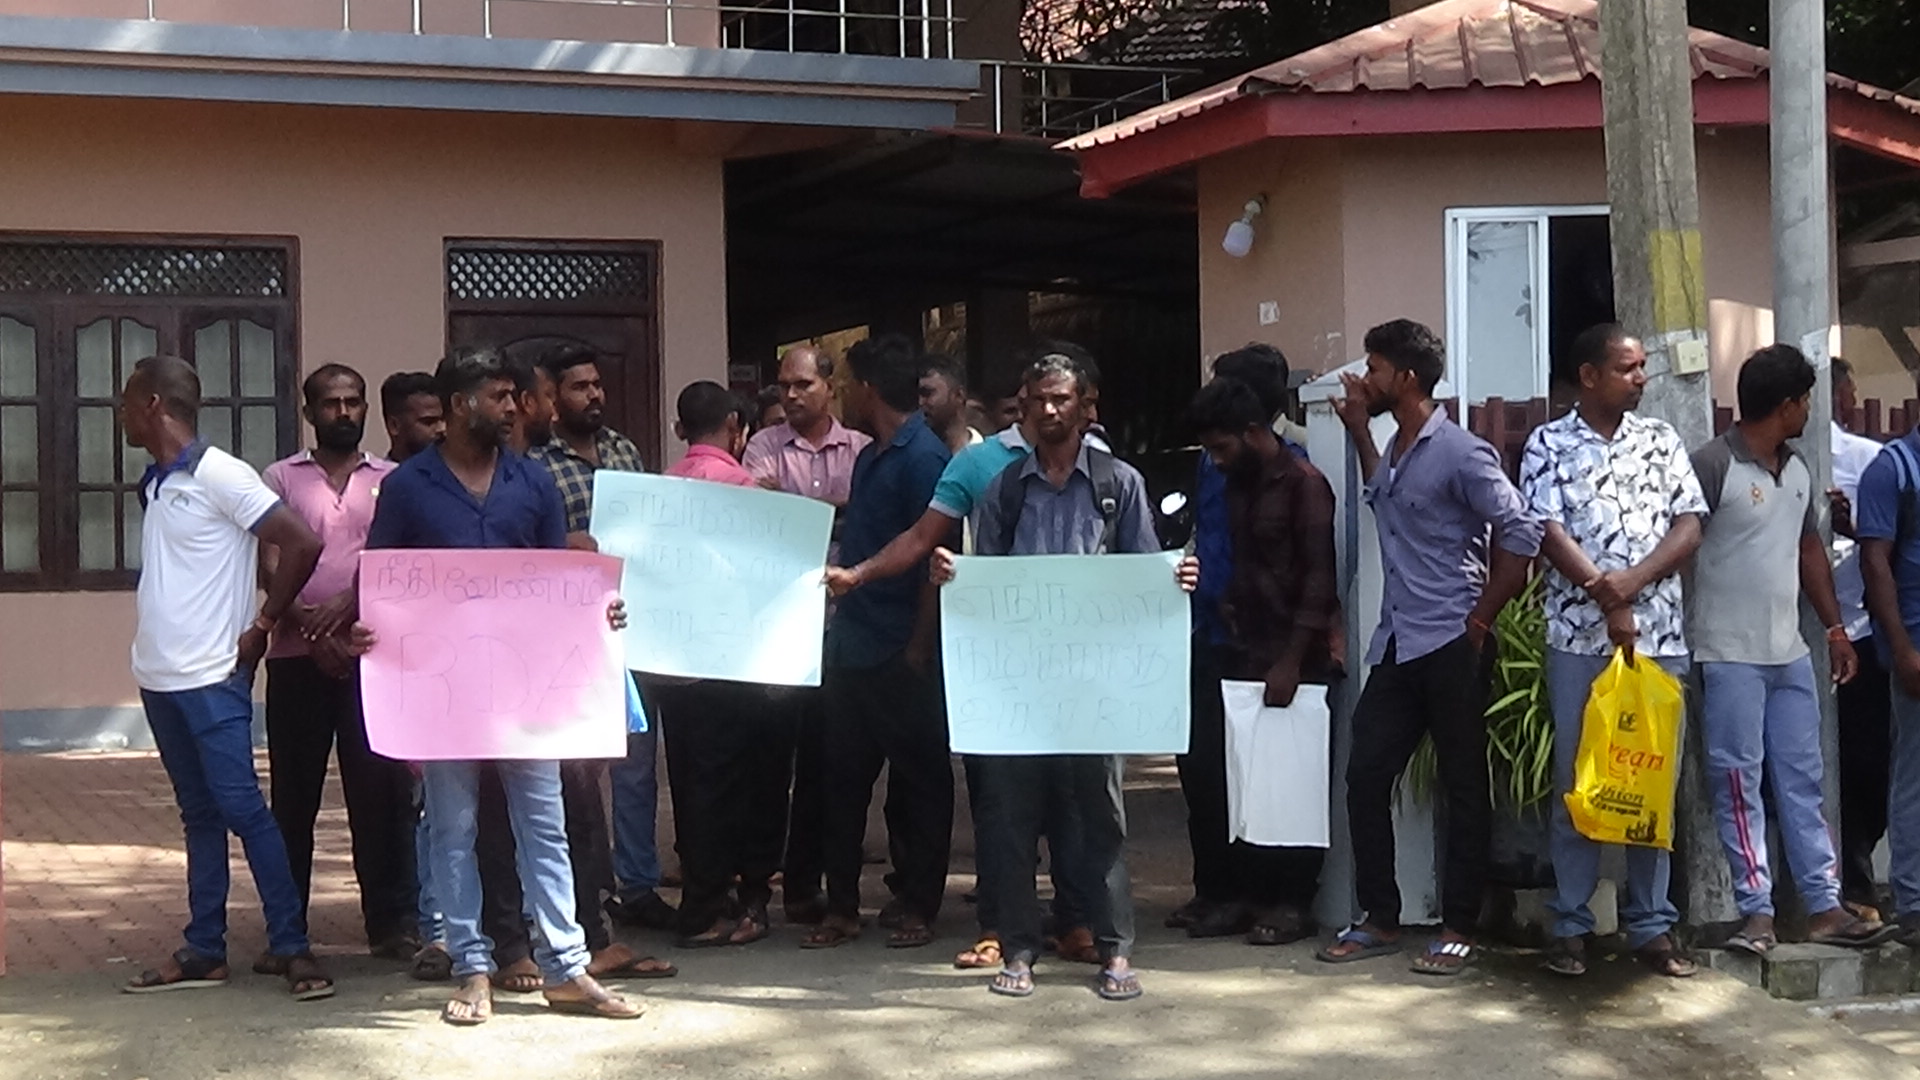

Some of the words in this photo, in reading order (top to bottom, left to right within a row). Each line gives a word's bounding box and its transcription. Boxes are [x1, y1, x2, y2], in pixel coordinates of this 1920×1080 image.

[370, 553, 437, 605] நீதி
[442, 560, 605, 608] வேண்டும்
[398, 632, 602, 718] RDA
[1091, 695, 1182, 738] RDA
